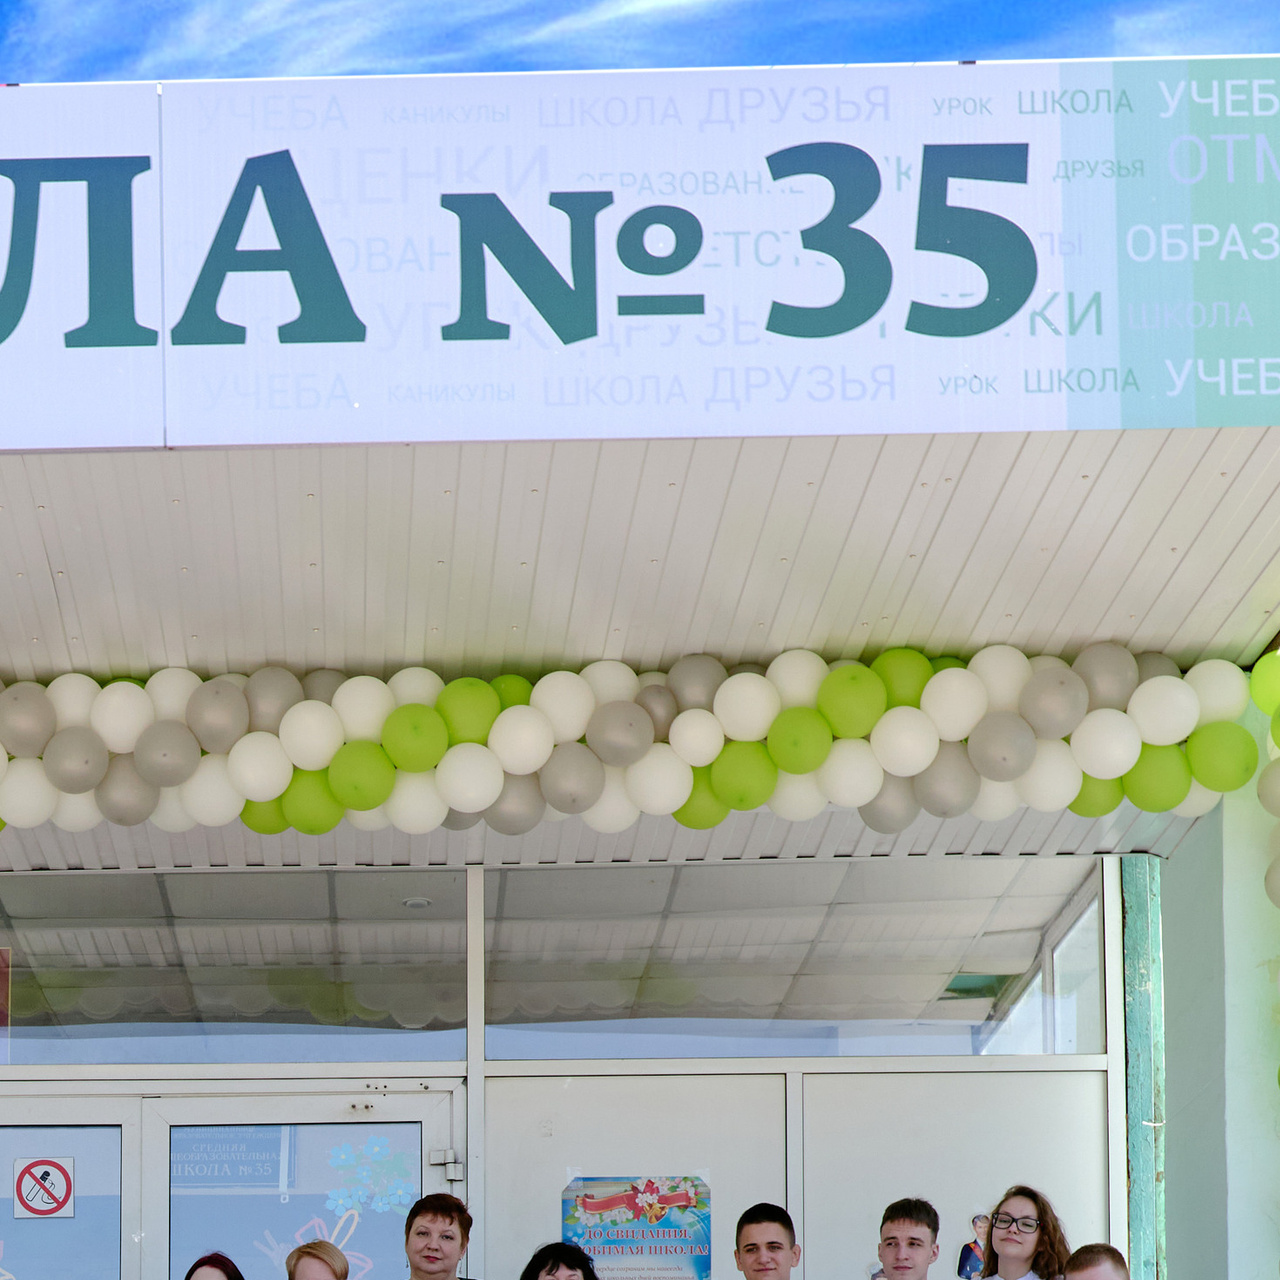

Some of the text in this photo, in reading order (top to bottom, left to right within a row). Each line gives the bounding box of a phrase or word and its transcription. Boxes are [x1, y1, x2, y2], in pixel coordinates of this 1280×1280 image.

[382, 103, 511, 125] КАНИКУЛЫ
[538, 96, 683, 128] ШКОЛА
[699, 85, 1134, 133] ДРУЗЬЯ УРОК ШКОЛА
[1053, 158, 1145, 182] ДРУЗЬЯ
[440, 191, 705, 346] №
[764, 141, 1039, 338] 35
[1129, 301, 1254, 331] ШКОЛА
[387, 382, 517, 404] КАНИКУЛЫ
[543, 374, 689, 408] ШКОЛА
[704, 364, 897, 412] ДРУЗЬЯ
[938, 376, 1000, 396] УРОК
[1023, 367, 1141, 395] ШКОЛА
[582, 1228, 692, 1241] ДО СВИДАНИЯ,
[648, 1244, 709, 1256] ШКОЛА!
